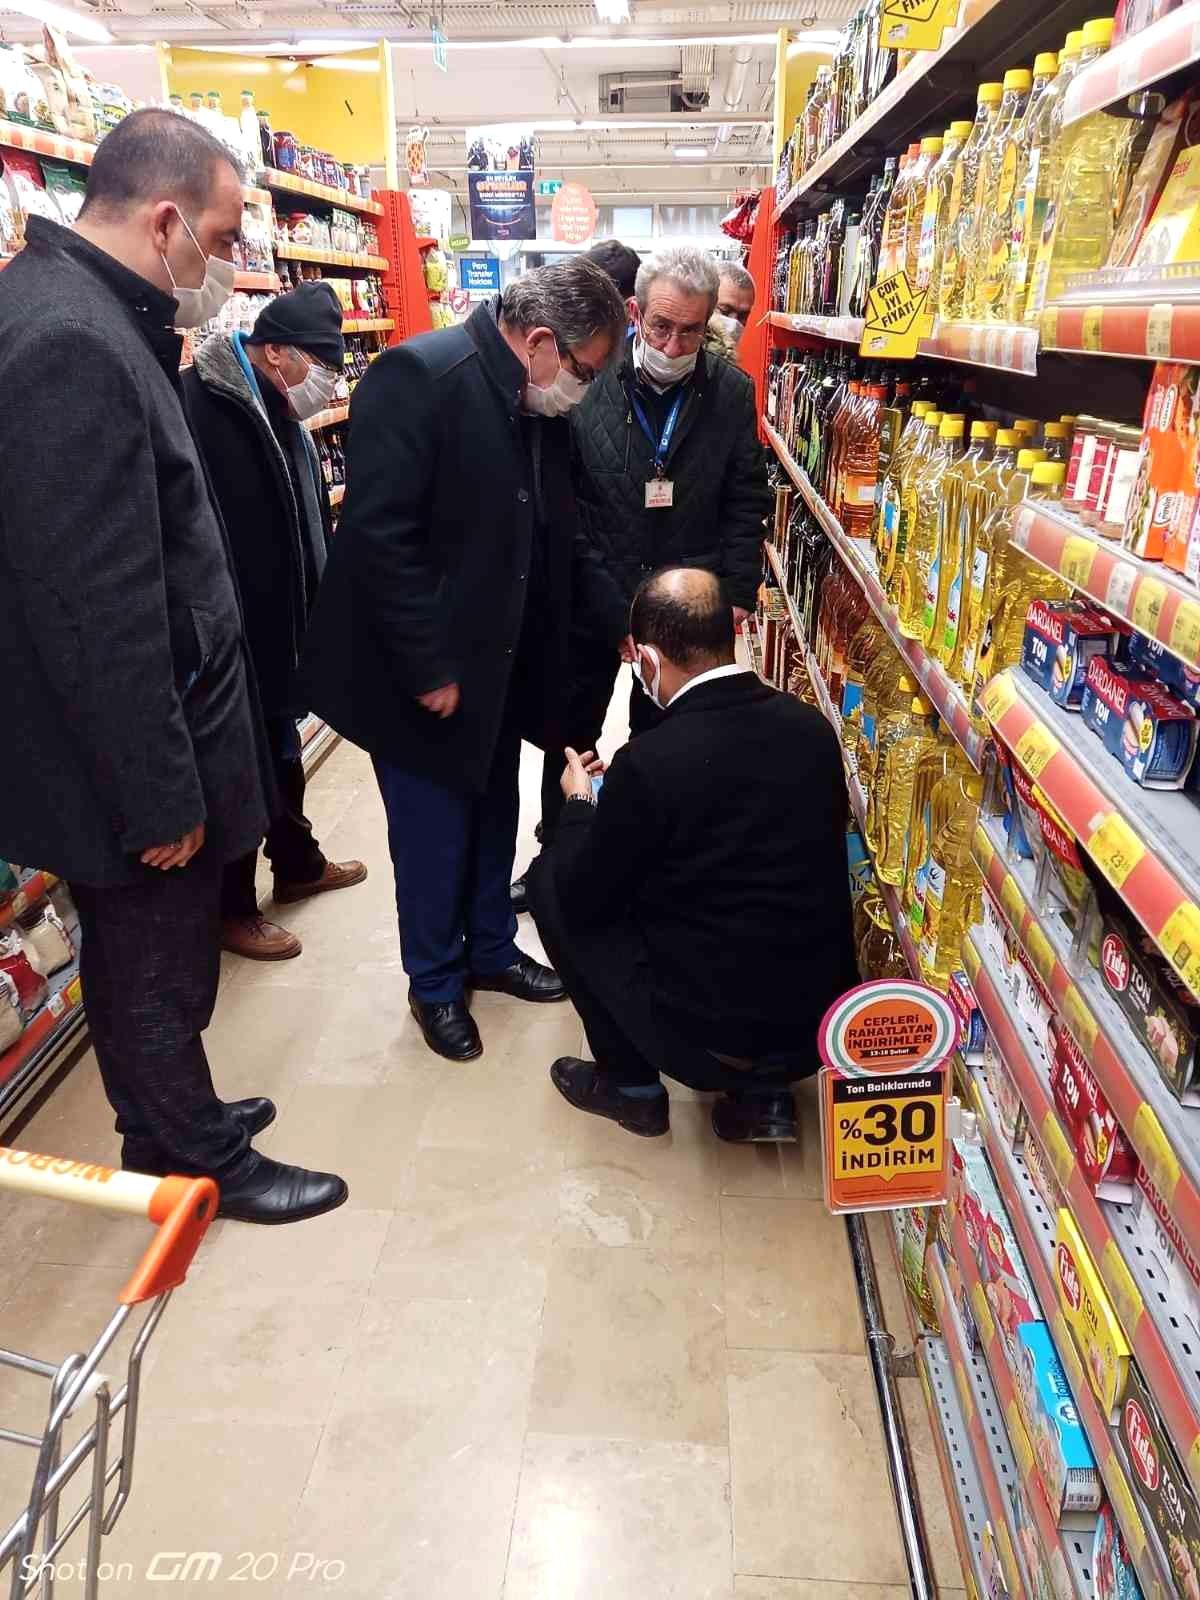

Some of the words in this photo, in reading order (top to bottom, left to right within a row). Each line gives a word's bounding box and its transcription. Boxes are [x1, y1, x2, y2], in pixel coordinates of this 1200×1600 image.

[881, 300, 915, 328] FİYAT!
[884, 292, 902, 311] İYİ
[1027, 604, 1063, 643] DARDANEL
[1032, 637, 1048, 663] TON
[1088, 660, 1127, 714] DARDANEL
[1095, 699, 1110, 724] TON
[1131, 963, 1152, 1004] TON
[848, 1024, 933, 1038] RAHATLATAN
[863, 1014, 919, 1027] CEPLERİ
[846, 1085, 865, 1095] Ton
[867, 1079, 932, 1092] Balıklarında
[1062, 1063, 1080, 1109] TON
[842, 1144, 935, 1171] İNDİRİM
[1084, 1286, 1098, 1330] TON
[1162, 1465, 1186, 1526] TON
